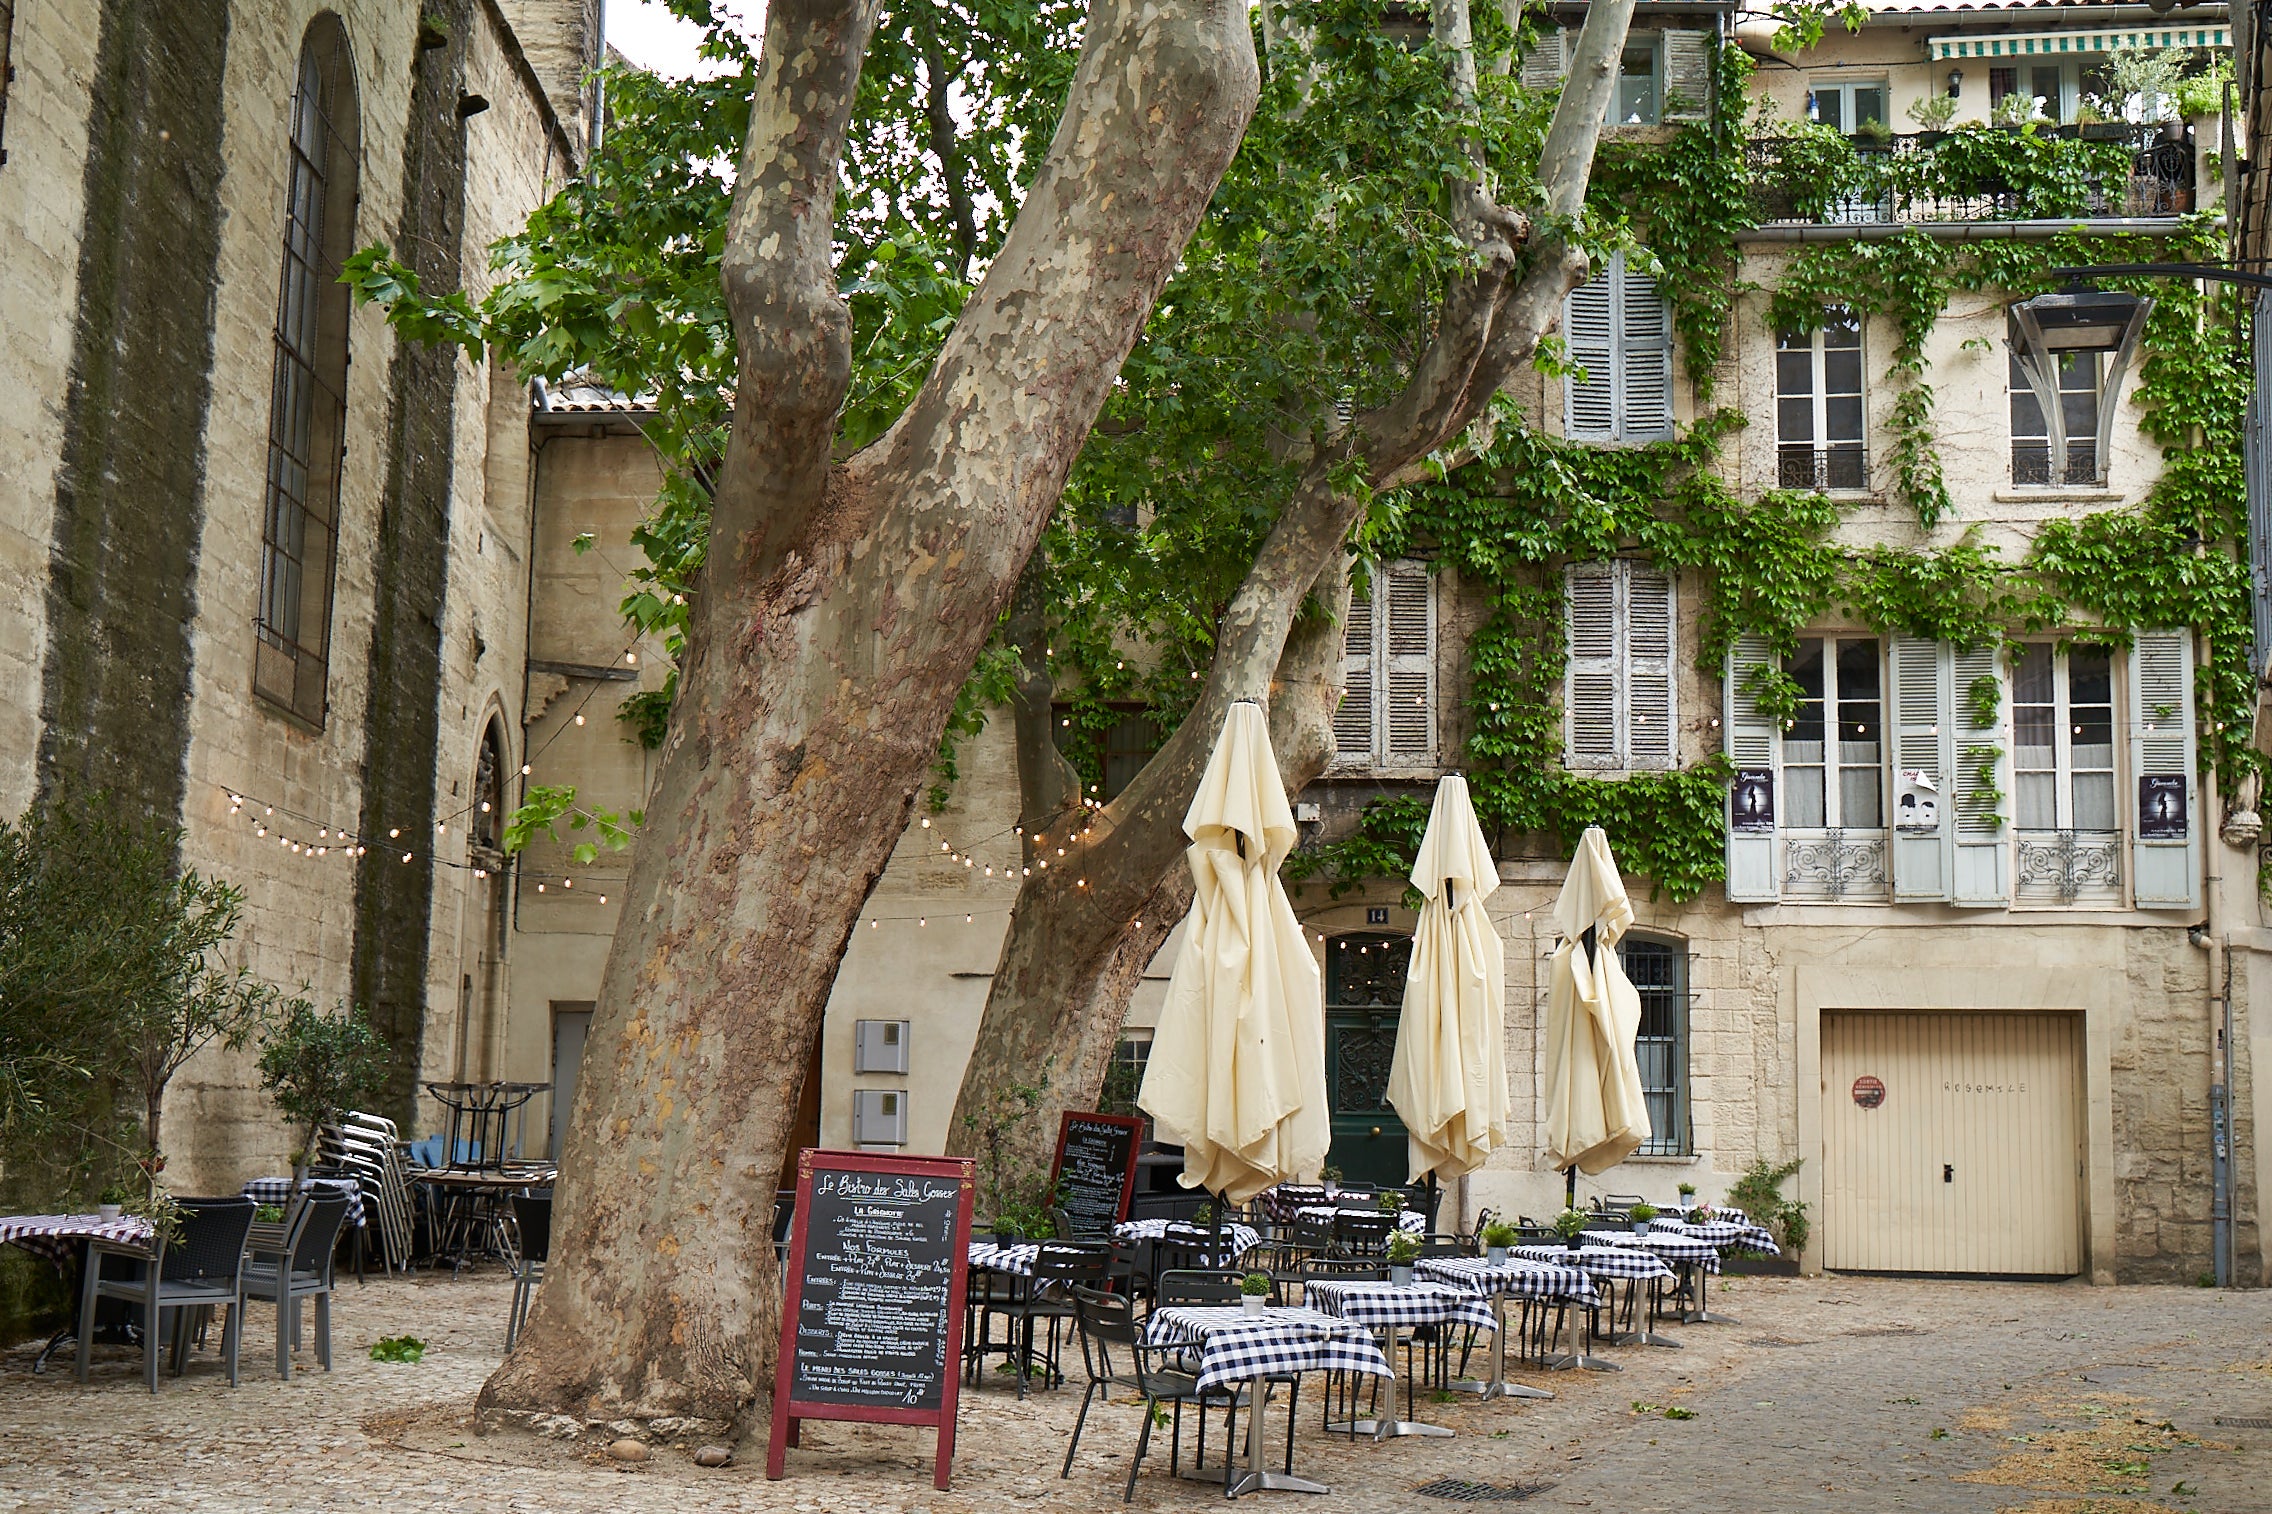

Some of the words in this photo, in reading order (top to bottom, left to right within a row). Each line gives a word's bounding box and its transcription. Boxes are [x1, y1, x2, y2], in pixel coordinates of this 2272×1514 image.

[1370, 910, 1385, 922] 14
[817, 1174, 835, 1195] Le
[837, 1174, 872, 1196] Bistro
[873, 1178, 891, 1196] des
[893, 1178, 920, 1198] Sales
[918, 1181, 958, 1203] Gosses
